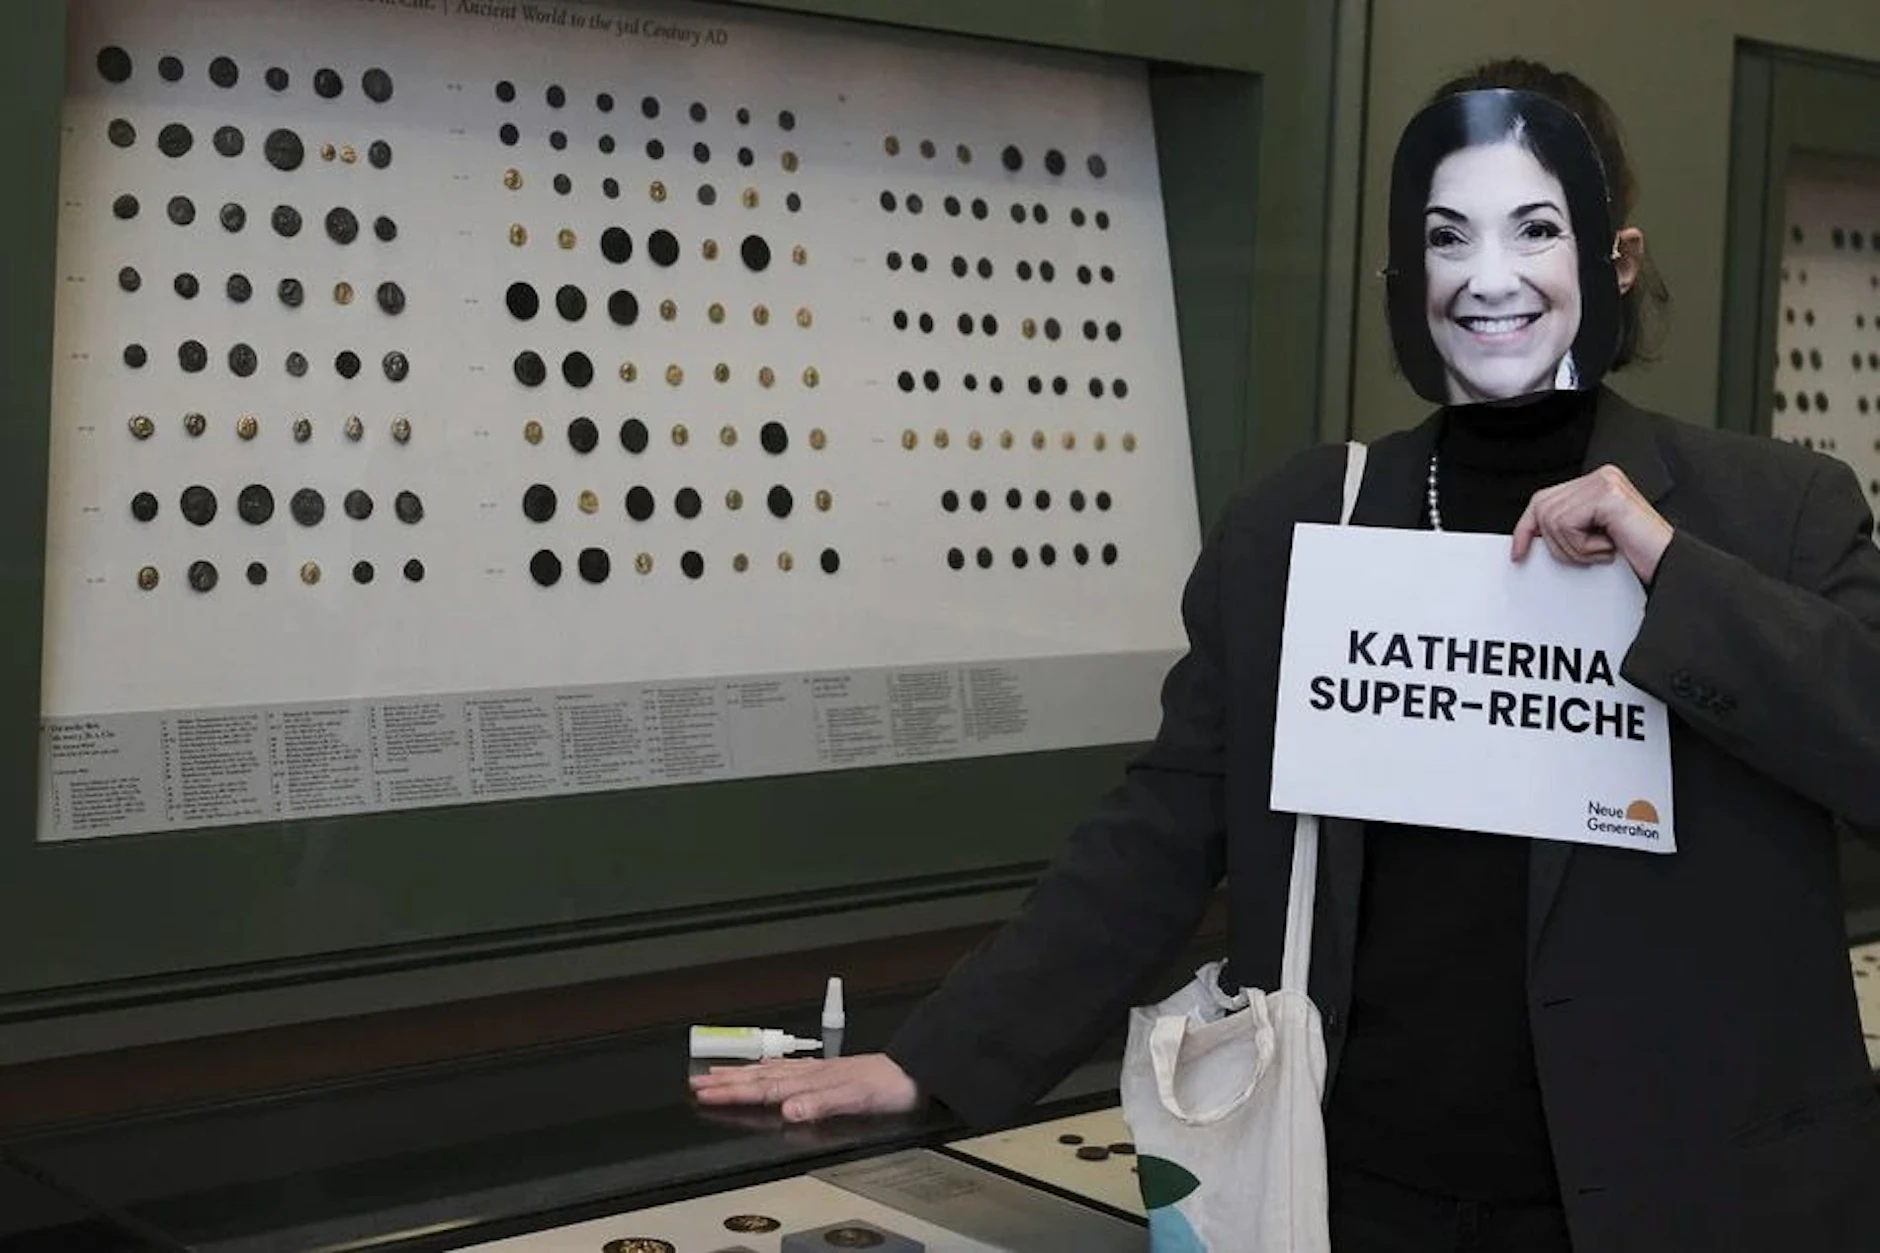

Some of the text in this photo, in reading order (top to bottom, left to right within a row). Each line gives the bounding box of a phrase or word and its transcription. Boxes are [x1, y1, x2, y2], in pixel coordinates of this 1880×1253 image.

[456, 0, 517, 20] Ancient
[522, 4, 567, 27] World
[571, 13, 586, 28] to
[590, 14, 612, 31] the
[616, 17, 640, 37] 3rd
[643, 20, 701, 47] Century
[705, 29, 729, 46] AD
[1348, 630, 1615, 686] KATHERINA
[1309, 676, 1646, 741] SUPER-REICHE
[1587, 817, 1659, 840] Generation
[1588, 800, 1624, 819] Neue
